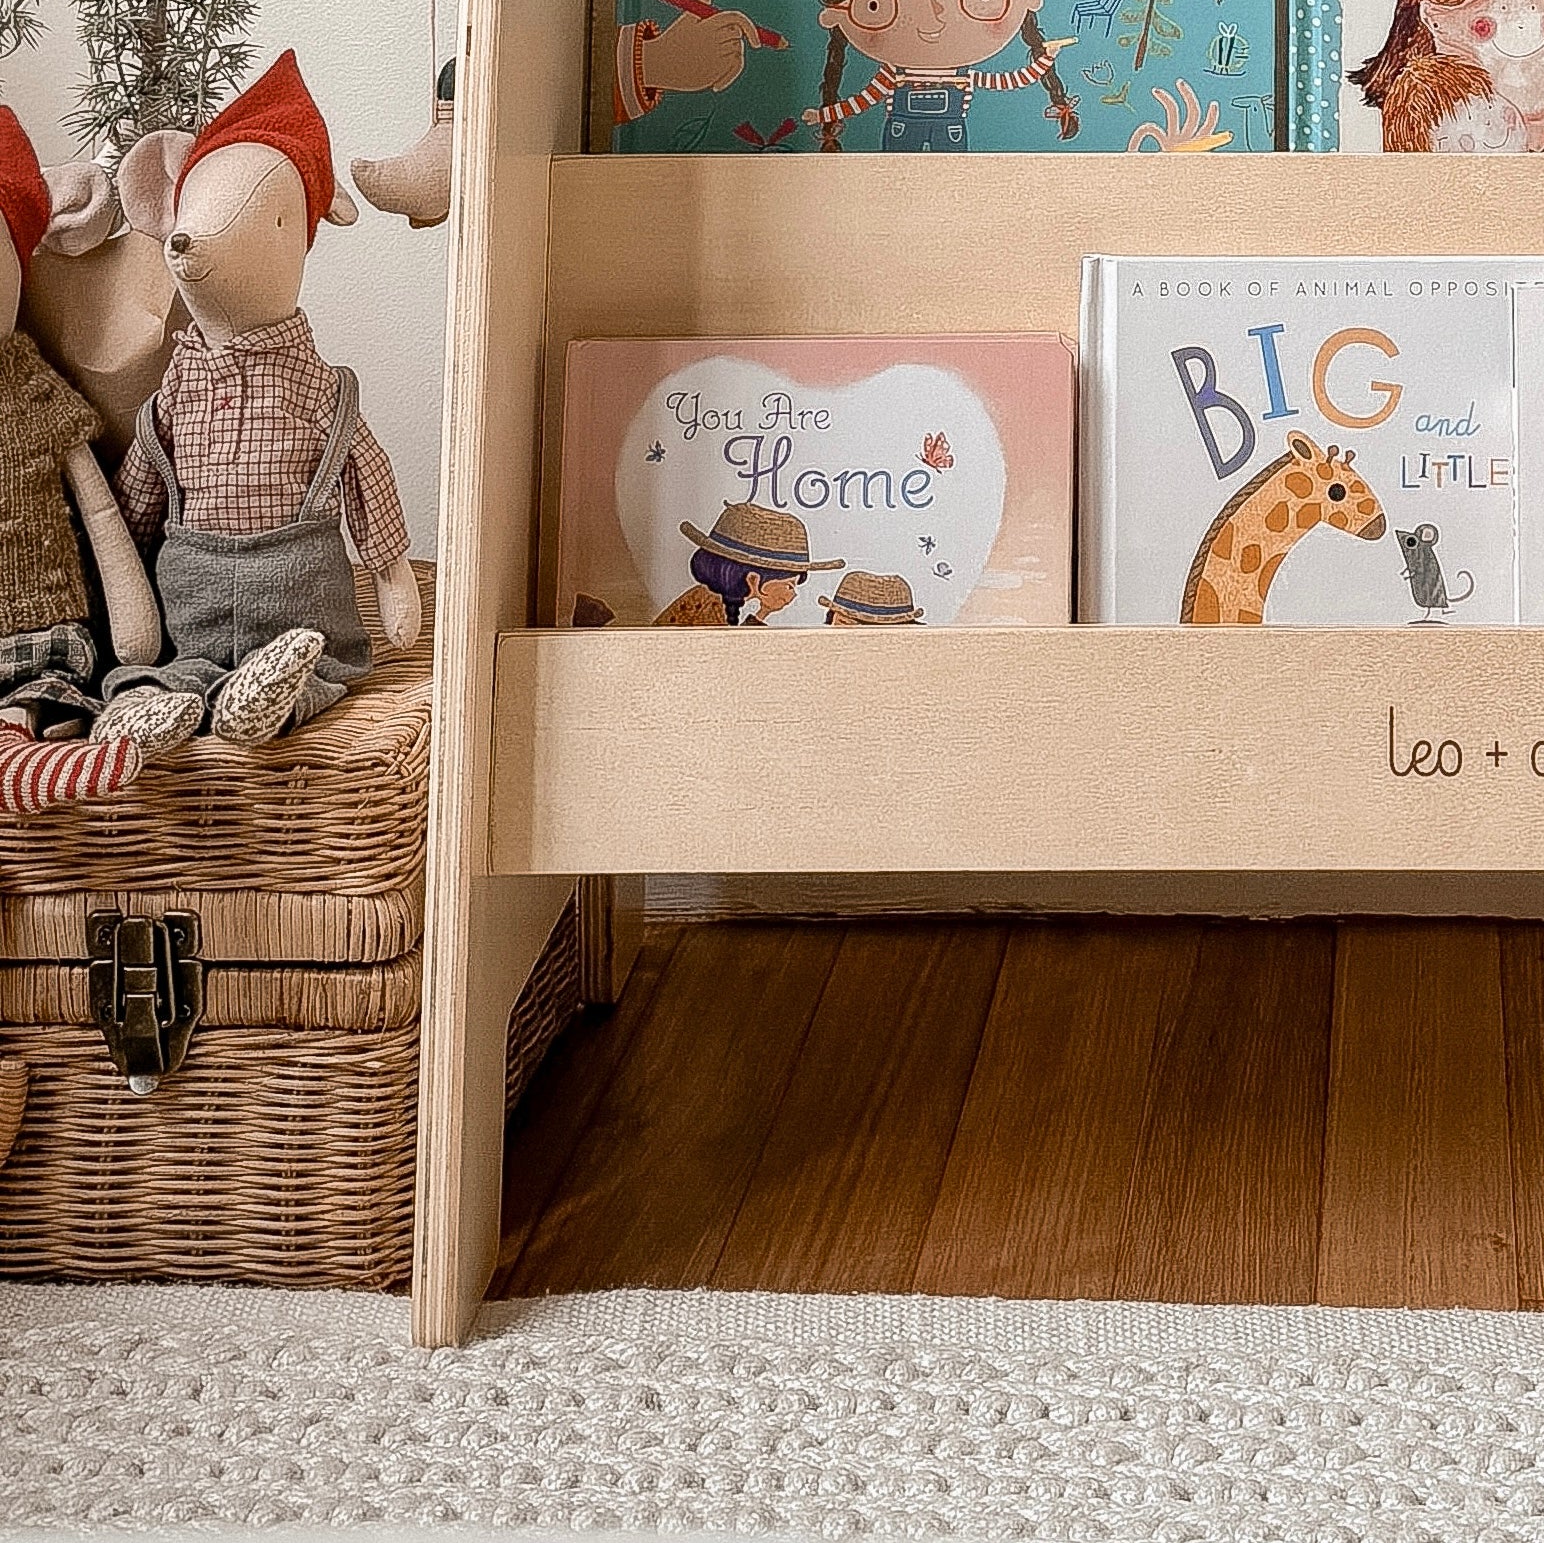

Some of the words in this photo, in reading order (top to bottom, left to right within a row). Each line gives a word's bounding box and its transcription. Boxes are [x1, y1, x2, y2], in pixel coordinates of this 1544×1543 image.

[1132, 282, 1144, 297] A
[1160, 282, 1231, 297] BOOK
[1248, 282, 1280, 297] OF
[1296, 282, 1393, 297] ANIMAL
[666, 391, 743, 439] You
[758, 391, 832, 431] Are
[1170, 323, 1403, 480] BIG
[1415, 401, 1481, 437] and
[723, 434, 934, 510] Home
[1402, 453, 1509, 488] LITTLE
[1389, 706, 1463, 777] leo
